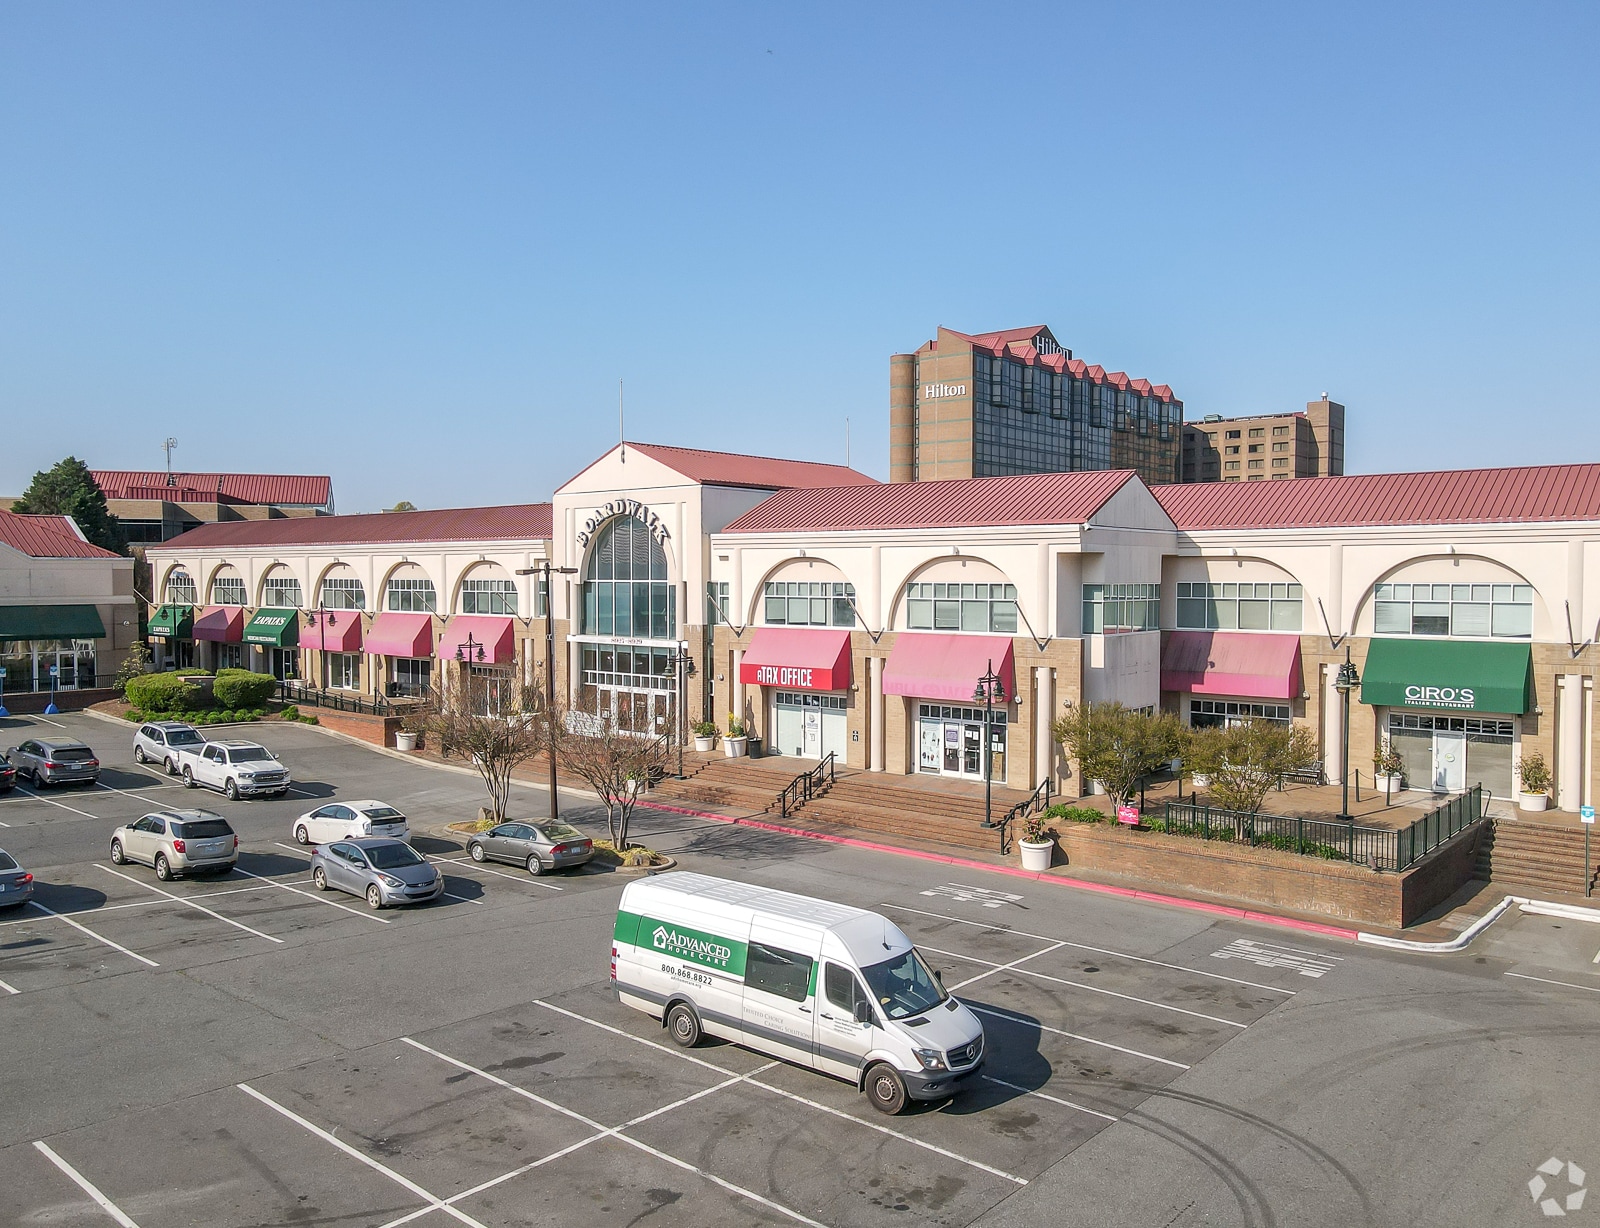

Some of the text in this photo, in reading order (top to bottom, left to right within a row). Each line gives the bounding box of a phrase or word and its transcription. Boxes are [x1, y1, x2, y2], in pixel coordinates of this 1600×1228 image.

[1036, 335, 1069, 361] Hilton
[925, 383, 966, 399] Hilton
[576, 499, 671, 548] BOARDWALK
[780, 667, 812, 687] OFFICE
[1405, 685, 1474, 702] CIRO'S
[667, 930, 731, 960] ADVANCED
[661, 963, 713, 986] 800.868.8822
[743, 1006, 784, 1025] TRUSTED CHOICE
